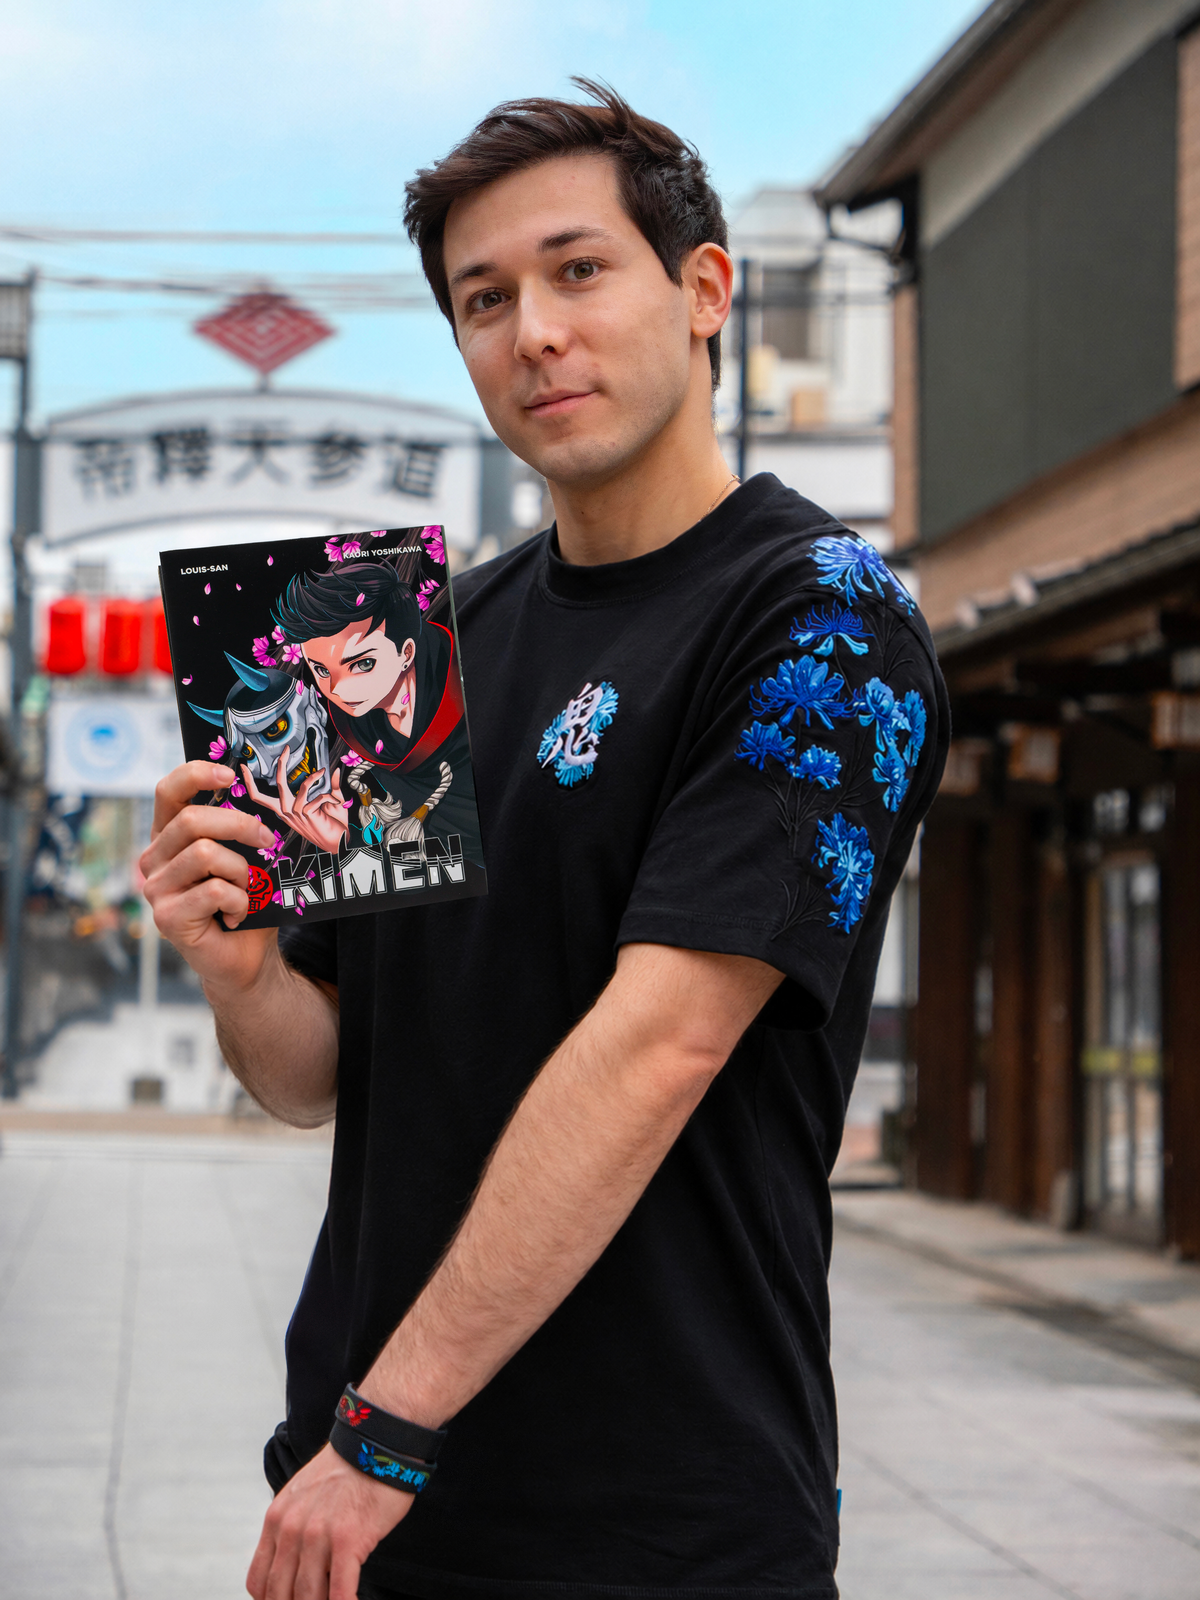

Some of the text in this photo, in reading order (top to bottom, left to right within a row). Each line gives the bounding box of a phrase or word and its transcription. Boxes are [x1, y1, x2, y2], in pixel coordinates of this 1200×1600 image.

[343, 545, 422, 560] KAORI YOSHIKAWA
[180, 564, 229, 576] LOUIS-SAN
[277, 831, 466, 910] KIMEN
